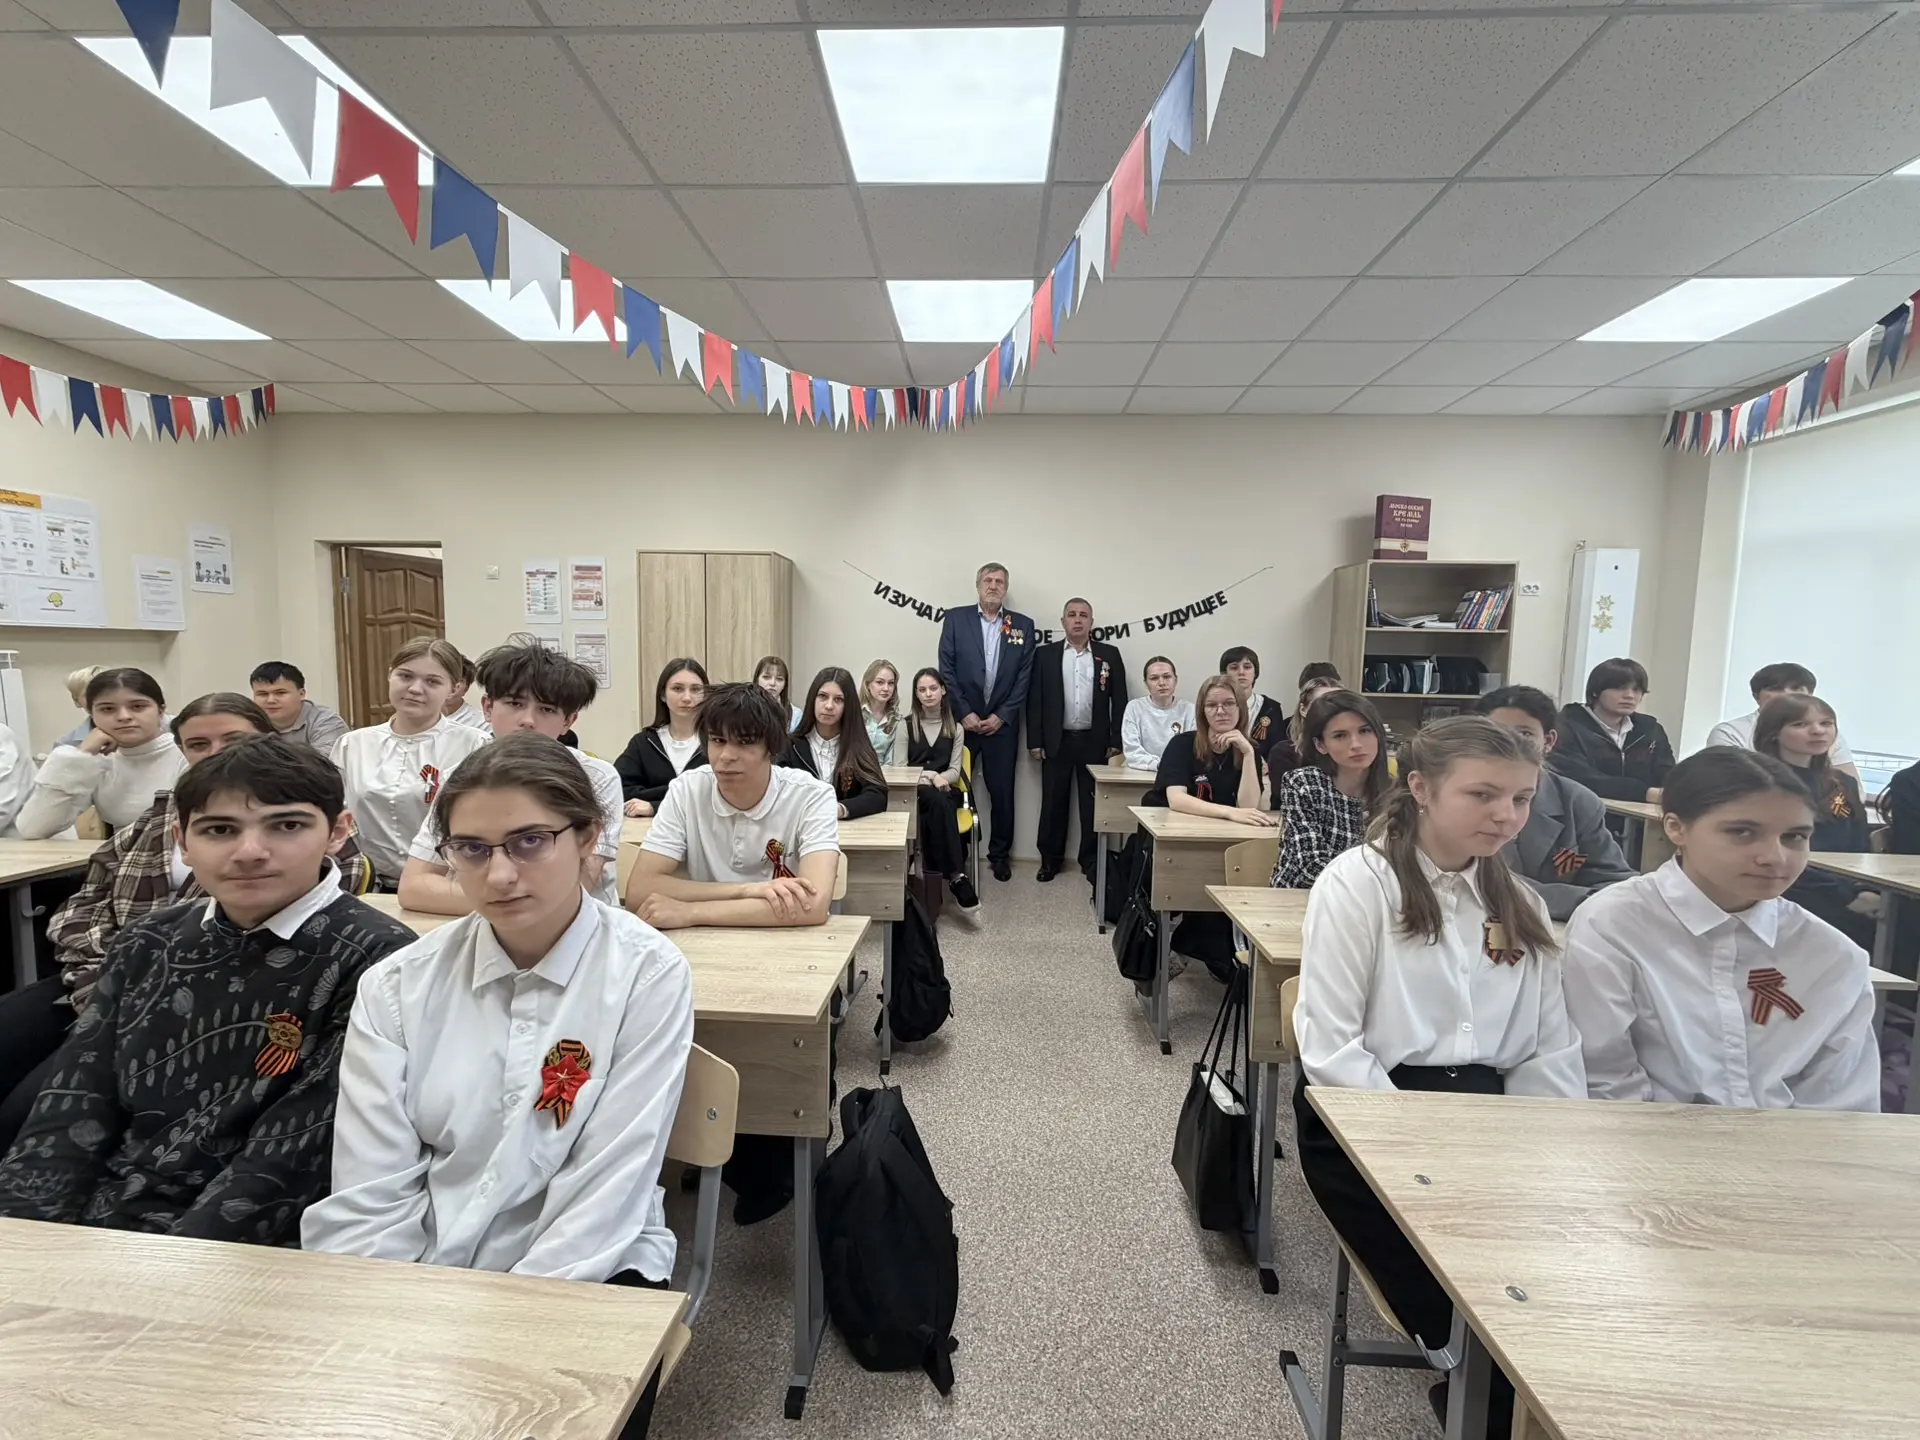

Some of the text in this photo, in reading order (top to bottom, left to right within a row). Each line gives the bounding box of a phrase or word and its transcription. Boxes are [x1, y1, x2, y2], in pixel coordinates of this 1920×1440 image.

[873, 581, 1228, 641] ИЗУЧАЙ ОРИ БУДУЩЕЕ
